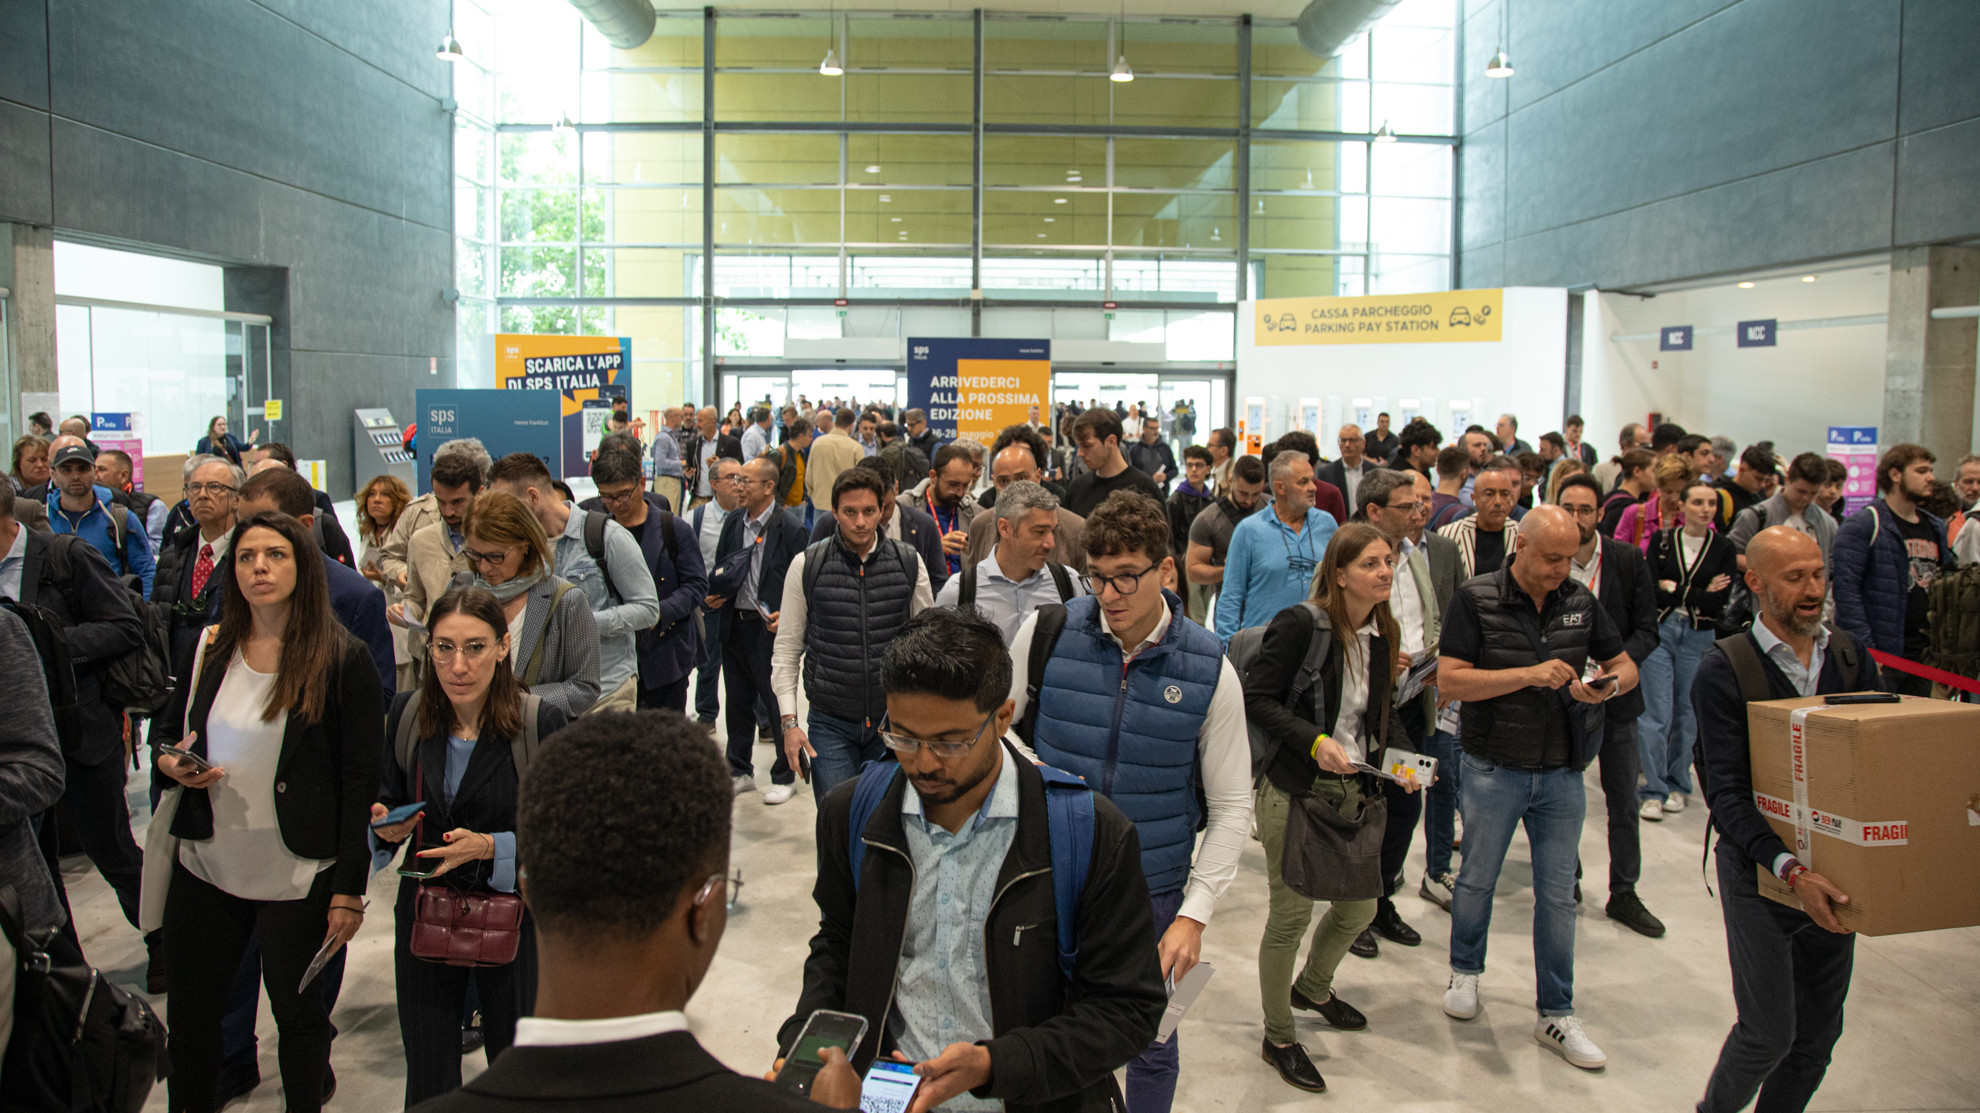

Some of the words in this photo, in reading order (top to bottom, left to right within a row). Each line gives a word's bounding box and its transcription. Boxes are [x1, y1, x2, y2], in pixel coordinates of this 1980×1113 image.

[1311, 308, 1349, 319] CASSA
[1352, 304, 1432, 318] PARCHEGGIO
[1305, 322, 1355, 334] PARKING
[1358, 321, 1382, 332] PAY
[1386, 319, 1439, 331] STATION
[914, 346, 929, 355] sps
[526, 356, 584, 374] SCARICA
[587, 354, 621, 370] L'APP
[508, 379, 522, 389] DI
[526, 377, 553, 390] SPS
[556, 373, 600, 390] ITALIA
[930, 376, 1020, 388] ARRIVEDERCI
[930, 392, 965, 404] ALLA
[968, 392, 1040, 405] PROSSIMA
[430, 409, 455, 425] sps
[930, 408, 993, 420] EDIZIONE
[431, 426, 452, 434] ITALIA
[960, 429, 994, 441] maggio
[1792, 723, 1804, 782] FRAGILE
[1757, 795, 1790, 818] FRAGILE
